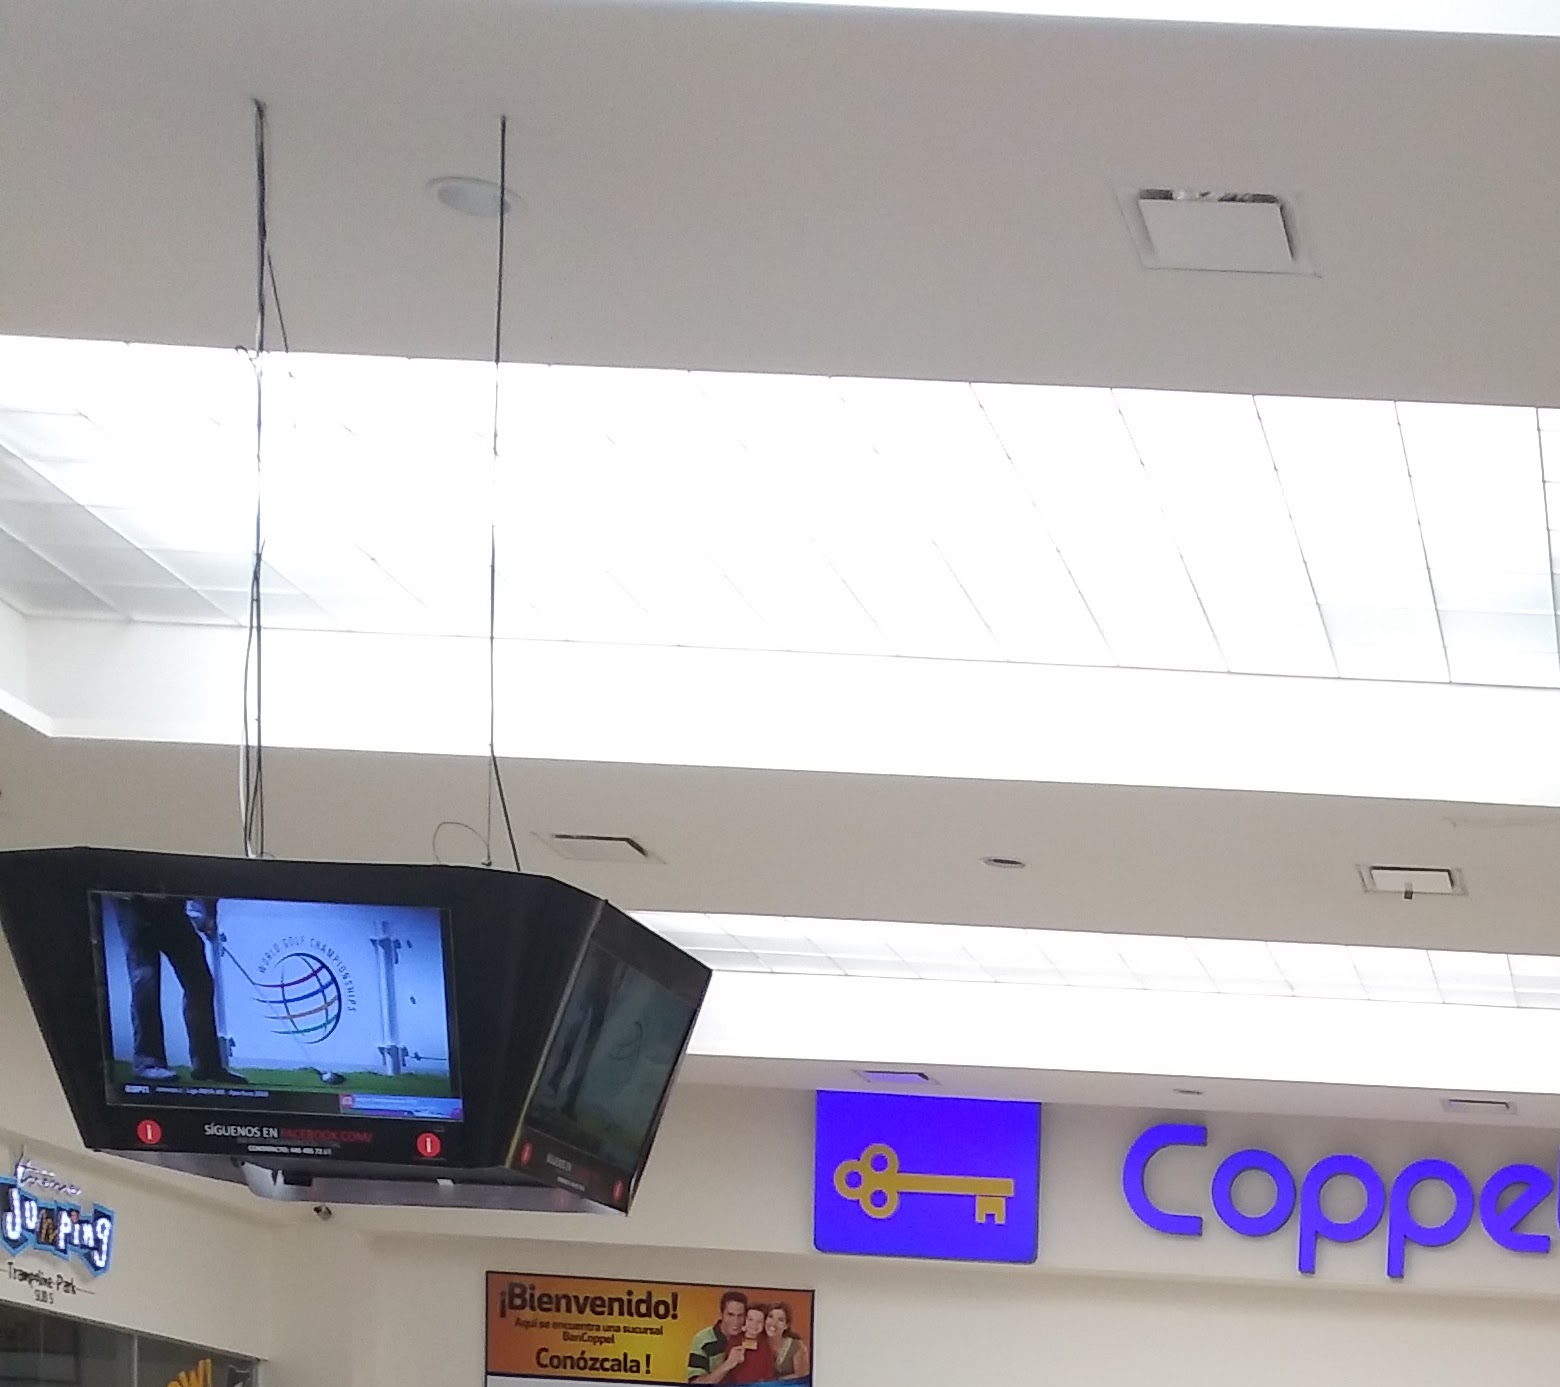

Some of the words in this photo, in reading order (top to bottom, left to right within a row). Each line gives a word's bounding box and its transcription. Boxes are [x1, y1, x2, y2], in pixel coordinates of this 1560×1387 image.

[258, 943, 281, 973] WORLD
[204, 1122, 261, 1138] SÍGUENOS
[262, 1127, 278, 1138] EN
[4, 1187, 112, 1268] Jumping
[56, 1274, 77, 1294] Park
[499, 1282, 679, 1320] ¡Bienvenido!
[552, 1322, 600, 1331] encuentra
[623, 1326, 664, 1335] sucursal
[562, 1331, 615, 1345] BanCoppel
